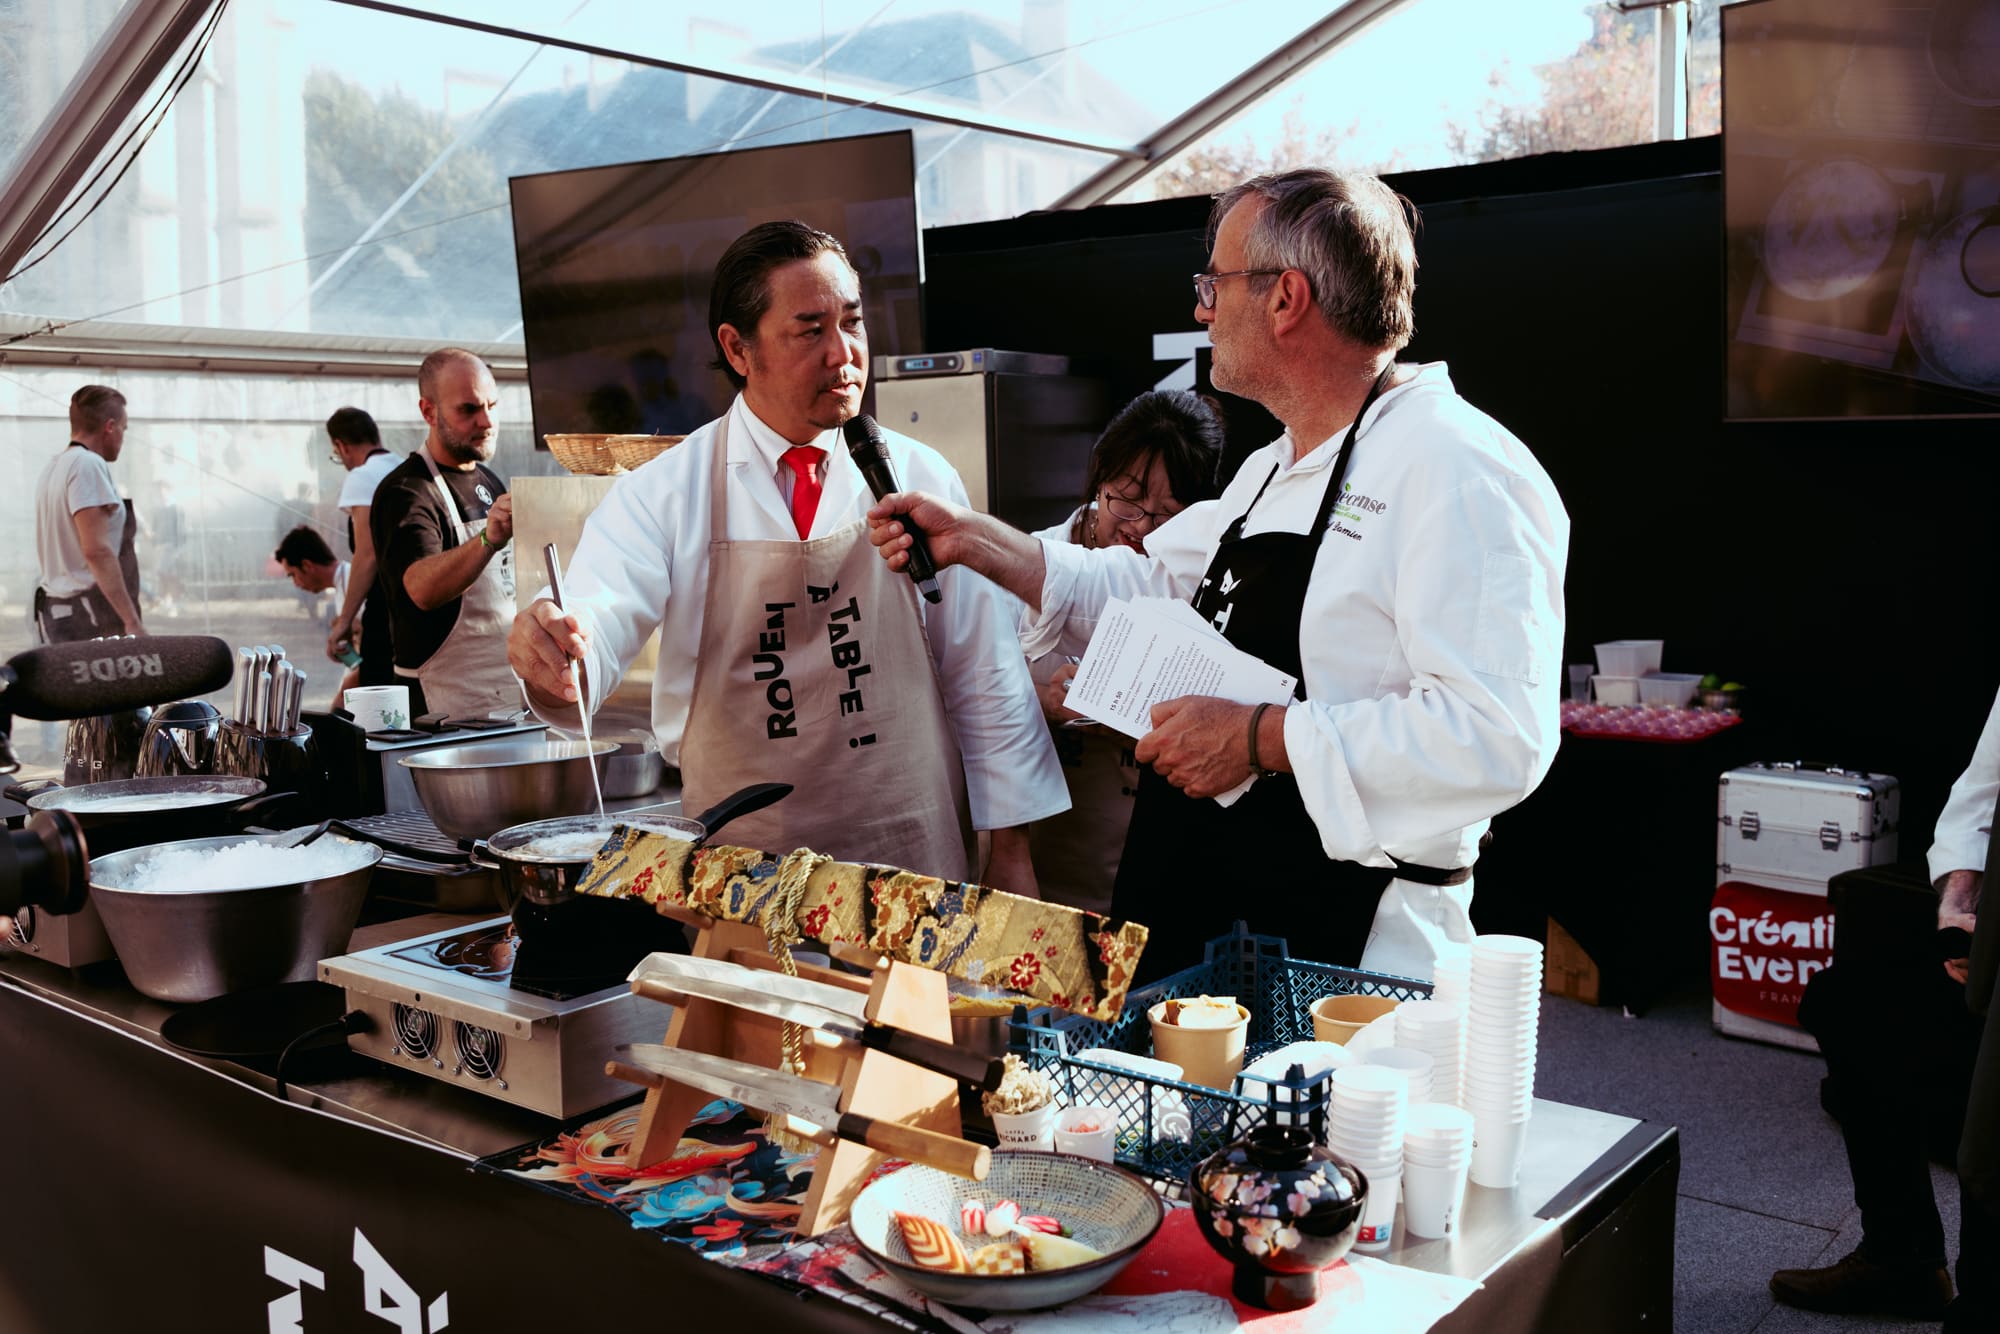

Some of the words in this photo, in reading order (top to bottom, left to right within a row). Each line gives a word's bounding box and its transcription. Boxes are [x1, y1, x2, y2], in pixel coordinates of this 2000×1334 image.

[70, 653, 164, 684] RØDE
[752, 601, 798, 740] ROUEN
[827, 596, 872, 718] TABLE
[1709, 906, 1836, 950] Créati
[1718, 946, 1834, 986] Even
[1759, 991, 1802, 1005] FRAN
